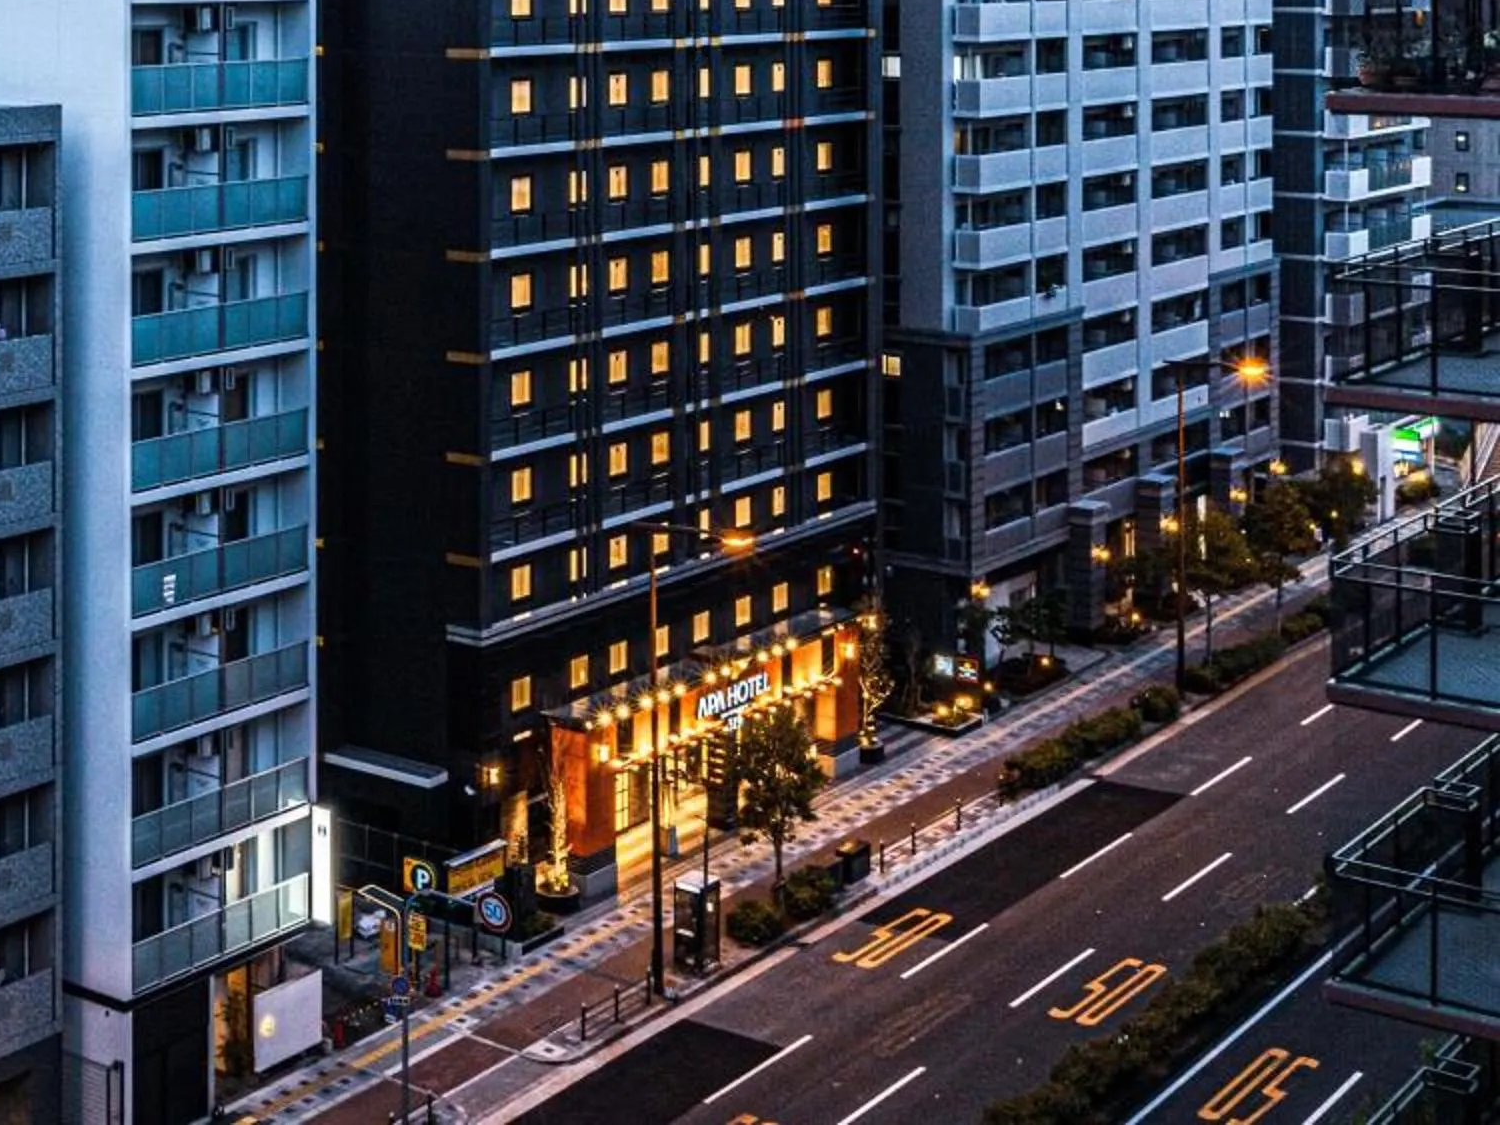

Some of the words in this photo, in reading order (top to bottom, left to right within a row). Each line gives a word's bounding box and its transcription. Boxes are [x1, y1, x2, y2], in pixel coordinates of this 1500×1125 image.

[697, 690, 726, 720] APA
[727, 672, 771, 707] HOTEL
[415, 868, 431, 891] P
[484, 901, 503, 922] 50
[832, 907, 953, 969] 50
[1047, 956, 1168, 1027] 50
